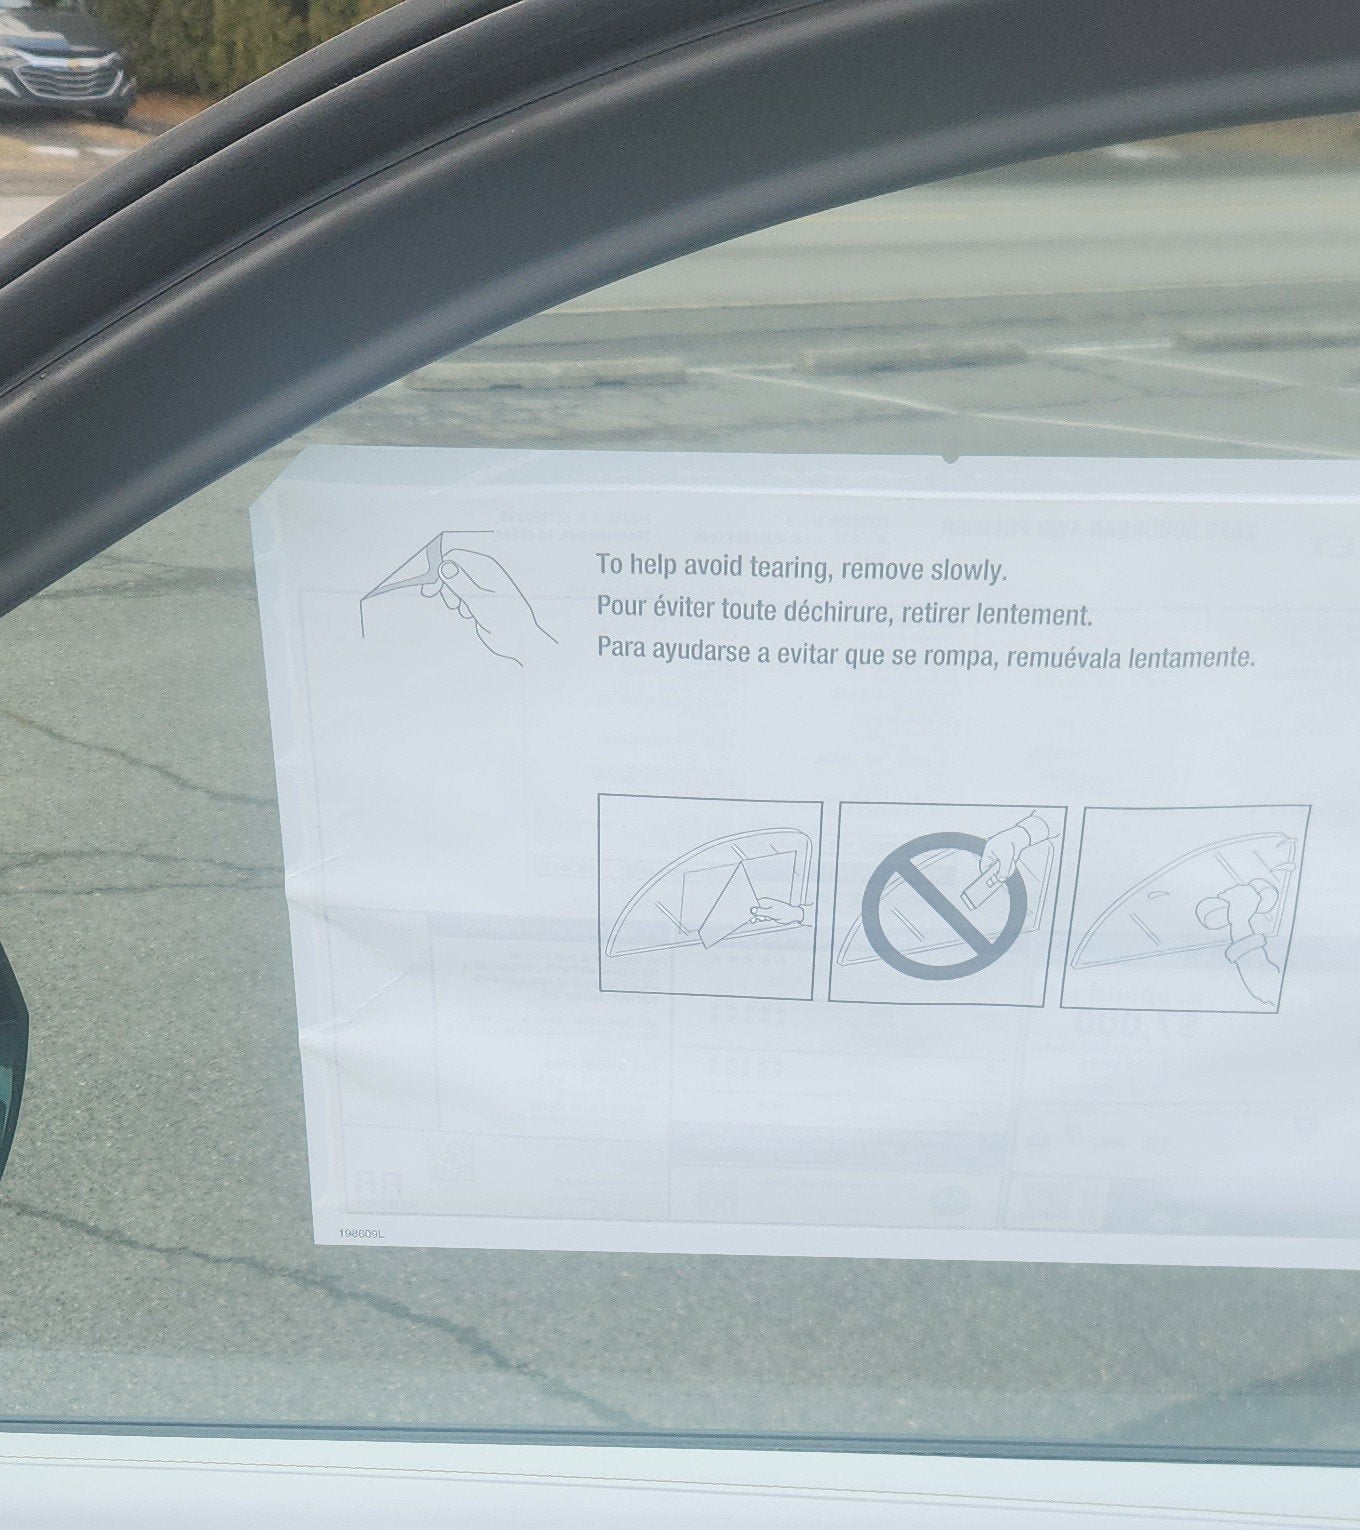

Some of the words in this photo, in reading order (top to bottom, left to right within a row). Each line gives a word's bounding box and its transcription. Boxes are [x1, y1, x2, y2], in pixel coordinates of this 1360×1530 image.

[595, 552, 623, 575] To
[630, 552, 677, 580] help
[684, 553, 743, 577] avoid
[749, 555, 833, 585] tearing,
[841, 561, 924, 582] remove
[931, 557, 1007, 587] slowly.
[597, 593, 647, 617] Pour
[653, 593, 716, 619] éviter
[720, 597, 777, 621] toute
[783, 598, 894, 627] déchirure,
[901, 601, 971, 625] retirer
[976, 602, 1093, 627] lentement.
[598, 635, 646, 658] Para
[652, 638, 751, 665] ayudarse
[757, 646, 771, 663] a
[777, 642, 839, 665] evitar
[845, 647, 885, 670] que
[891, 648, 917, 666] se
[924, 648, 999, 672] rompa,
[1007, 645, 1121, 669] remuévala
[1128, 646, 1255, 670] lentamente.
